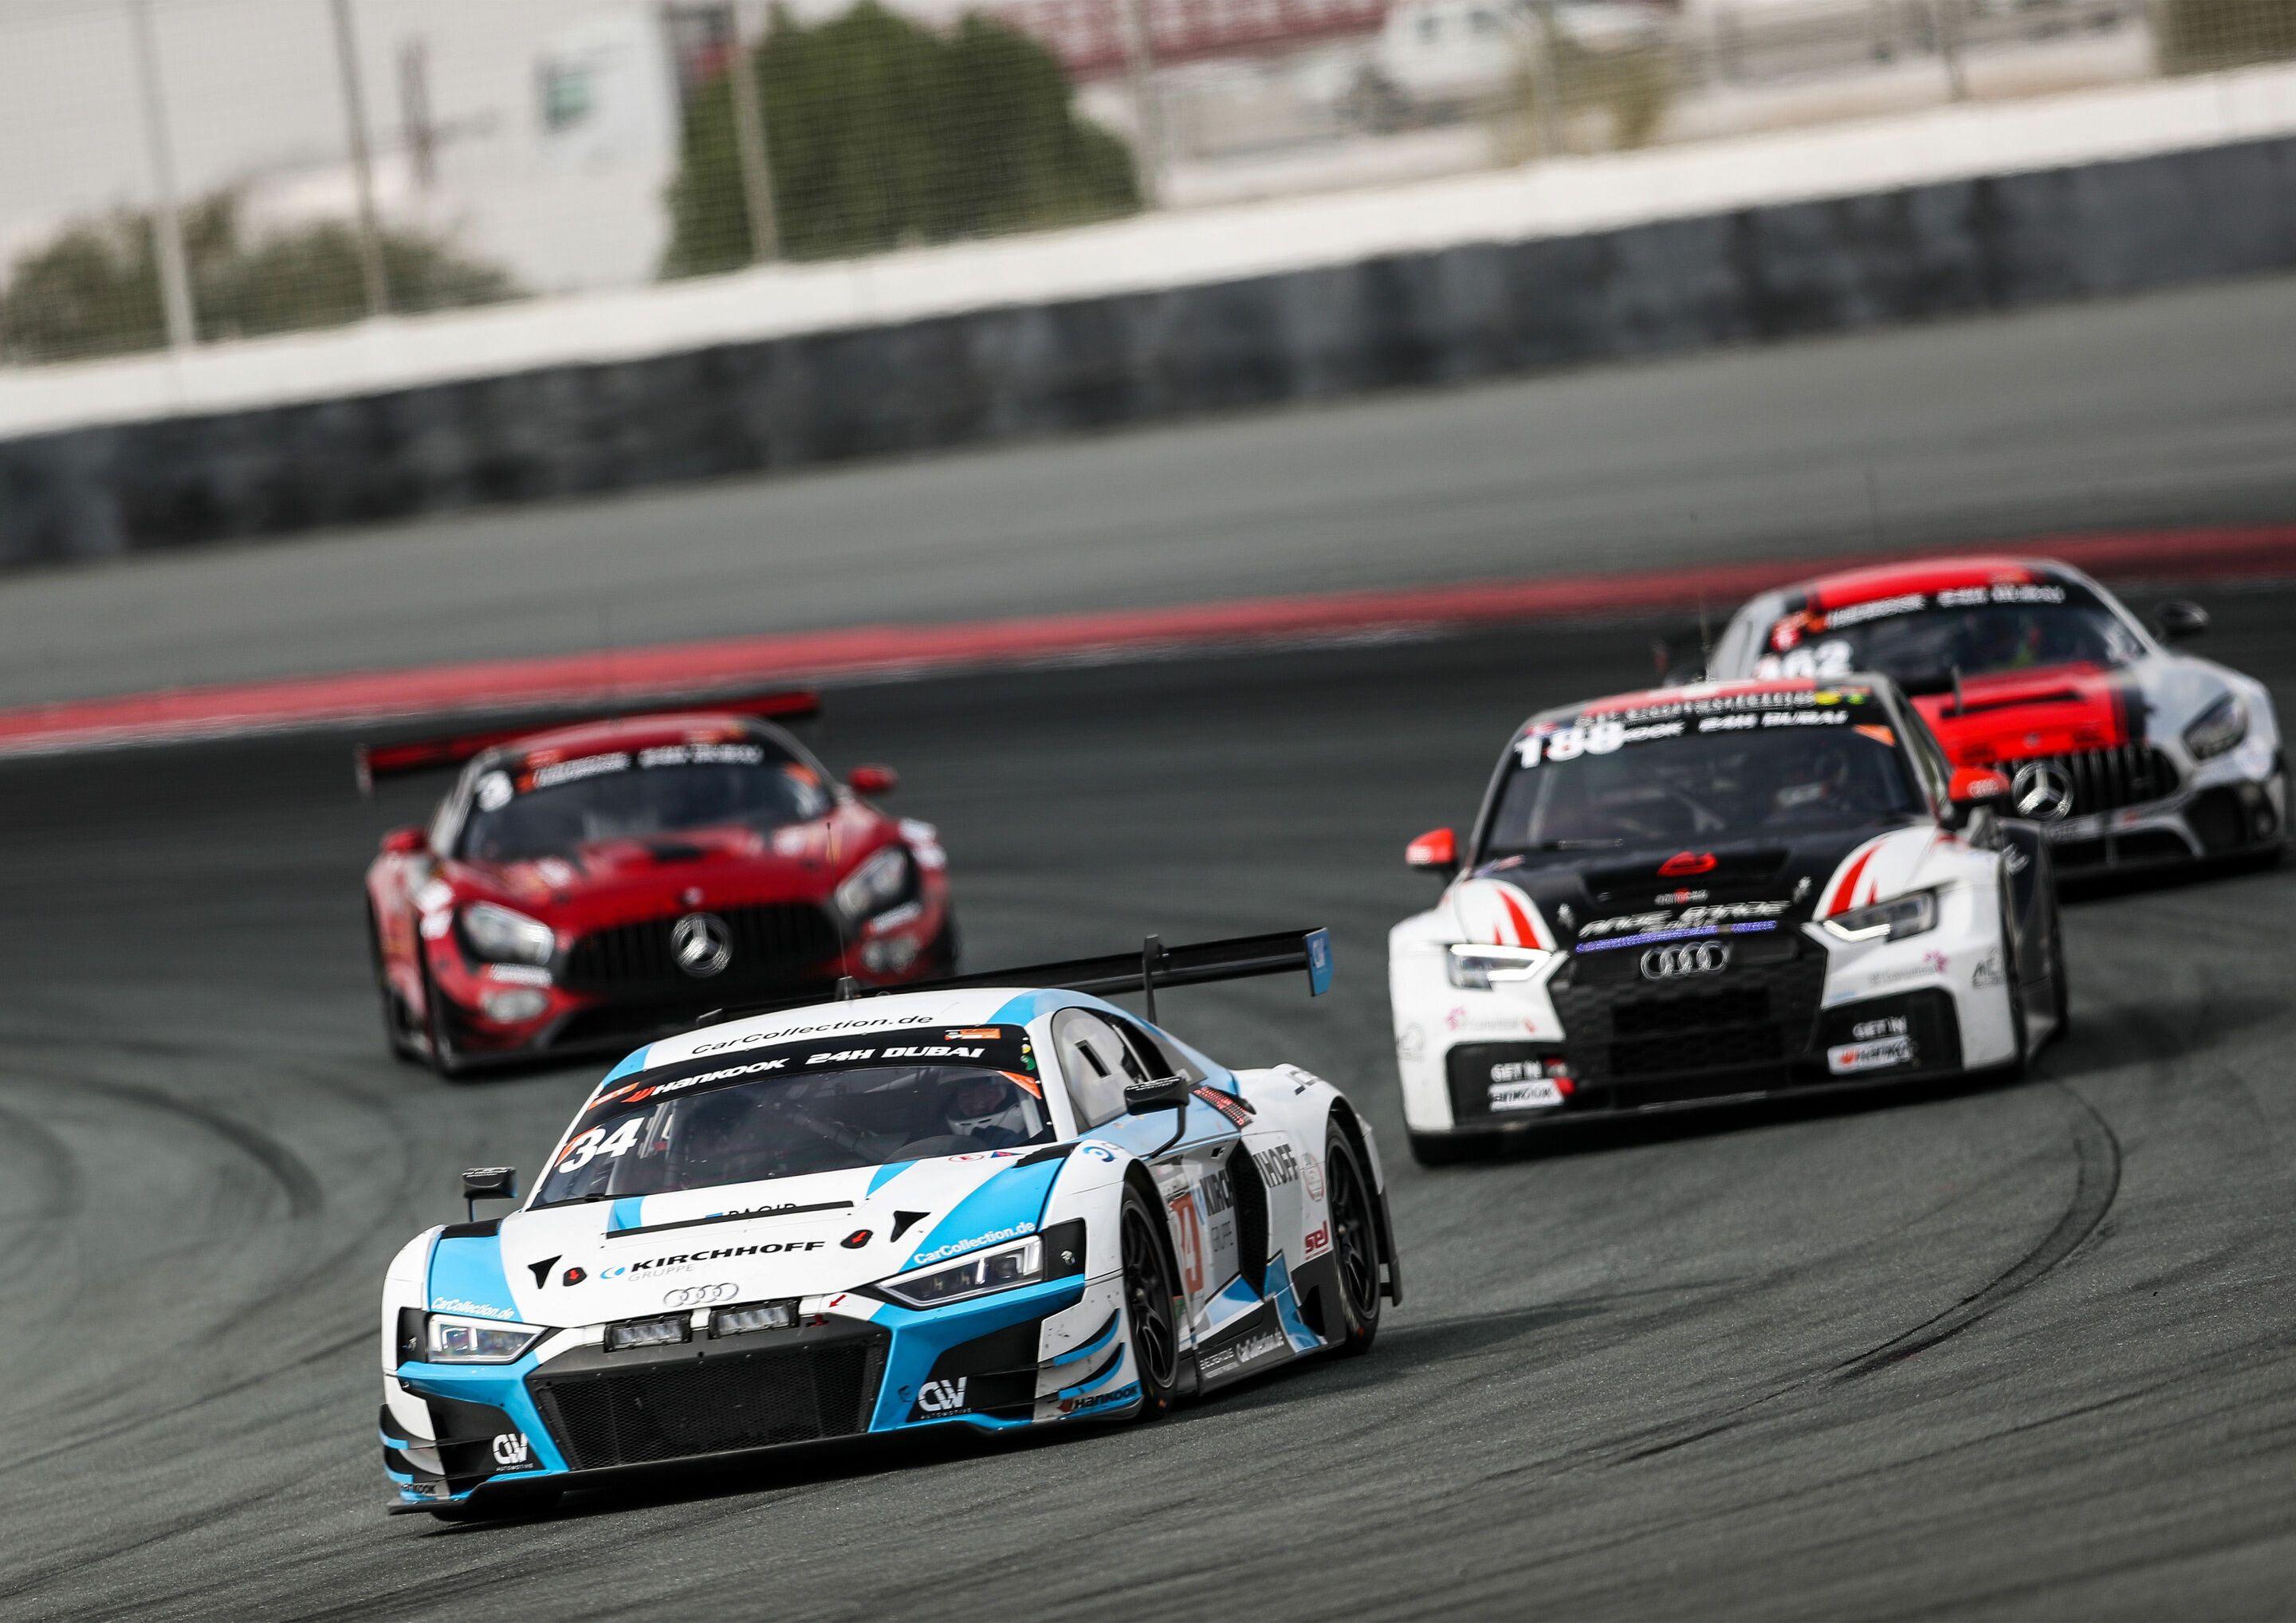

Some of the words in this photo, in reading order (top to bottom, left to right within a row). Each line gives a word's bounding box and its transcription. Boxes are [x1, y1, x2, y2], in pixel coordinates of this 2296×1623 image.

[1515, 721, 1627, 768] 188
[691, 1015, 934, 1055] CarCollection.de
[804, 1048, 876, 1065] 24H
[880, 1046, 985, 1059] DUBAI
[559, 1117, 645, 1174] 34
[631, 1240, 826, 1272] KIRCHHOFF
[914, 1220, 1036, 1264] CarCollection.de
[628, 1263, 695, 1282] GRUPPE
[431, 1296, 515, 1320] CarCollection.de
